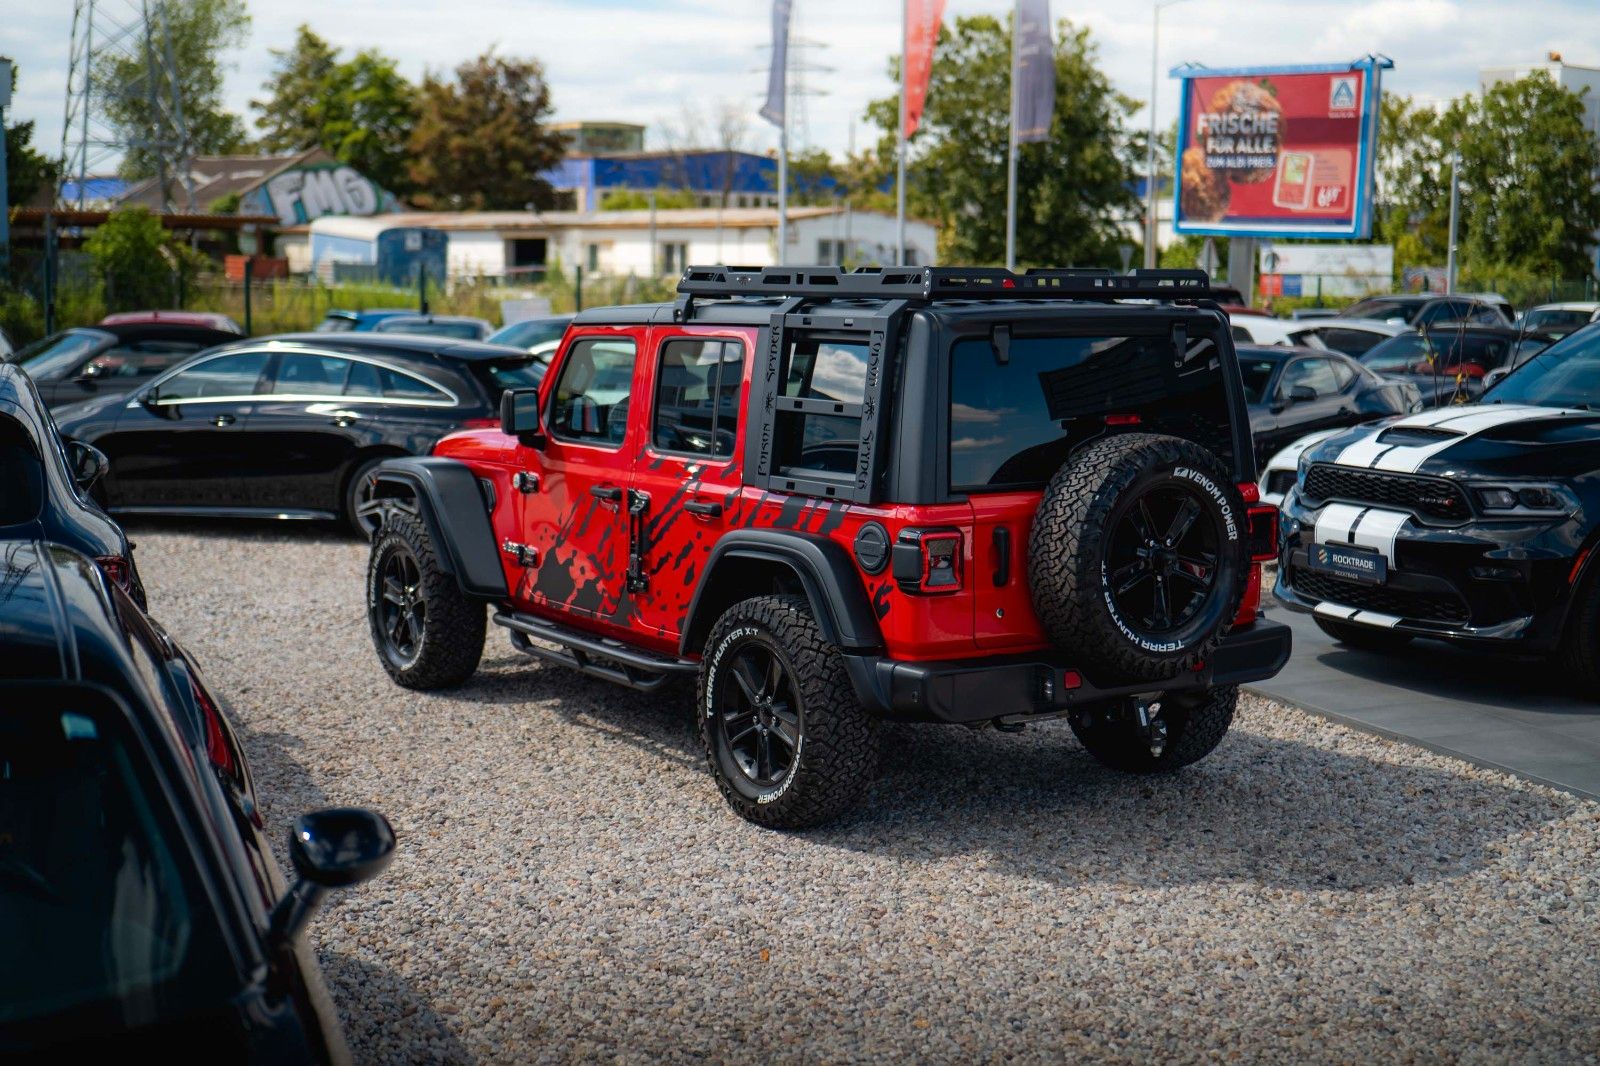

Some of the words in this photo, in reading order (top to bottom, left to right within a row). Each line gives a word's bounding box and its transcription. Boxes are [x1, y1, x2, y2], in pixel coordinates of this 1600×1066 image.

[1197, 112, 1280, 134] FRISCHE
[1206, 136, 1239, 154] FÜR
[1240, 135, 1276, 153] ALLE.
[1188, 469, 1221, 499] VENOM
[1217, 497, 1239, 541] POWER
[1332, 554, 1374, 569] ROCKTRADE
[1104, 591, 1140, 645] HUNTER
[1141, 639, 1185, 652] TERRA
[706, 666, 716, 719] TERRA
[715, 628, 744, 666] HUNTER
[757, 788, 784, 805] POWER
